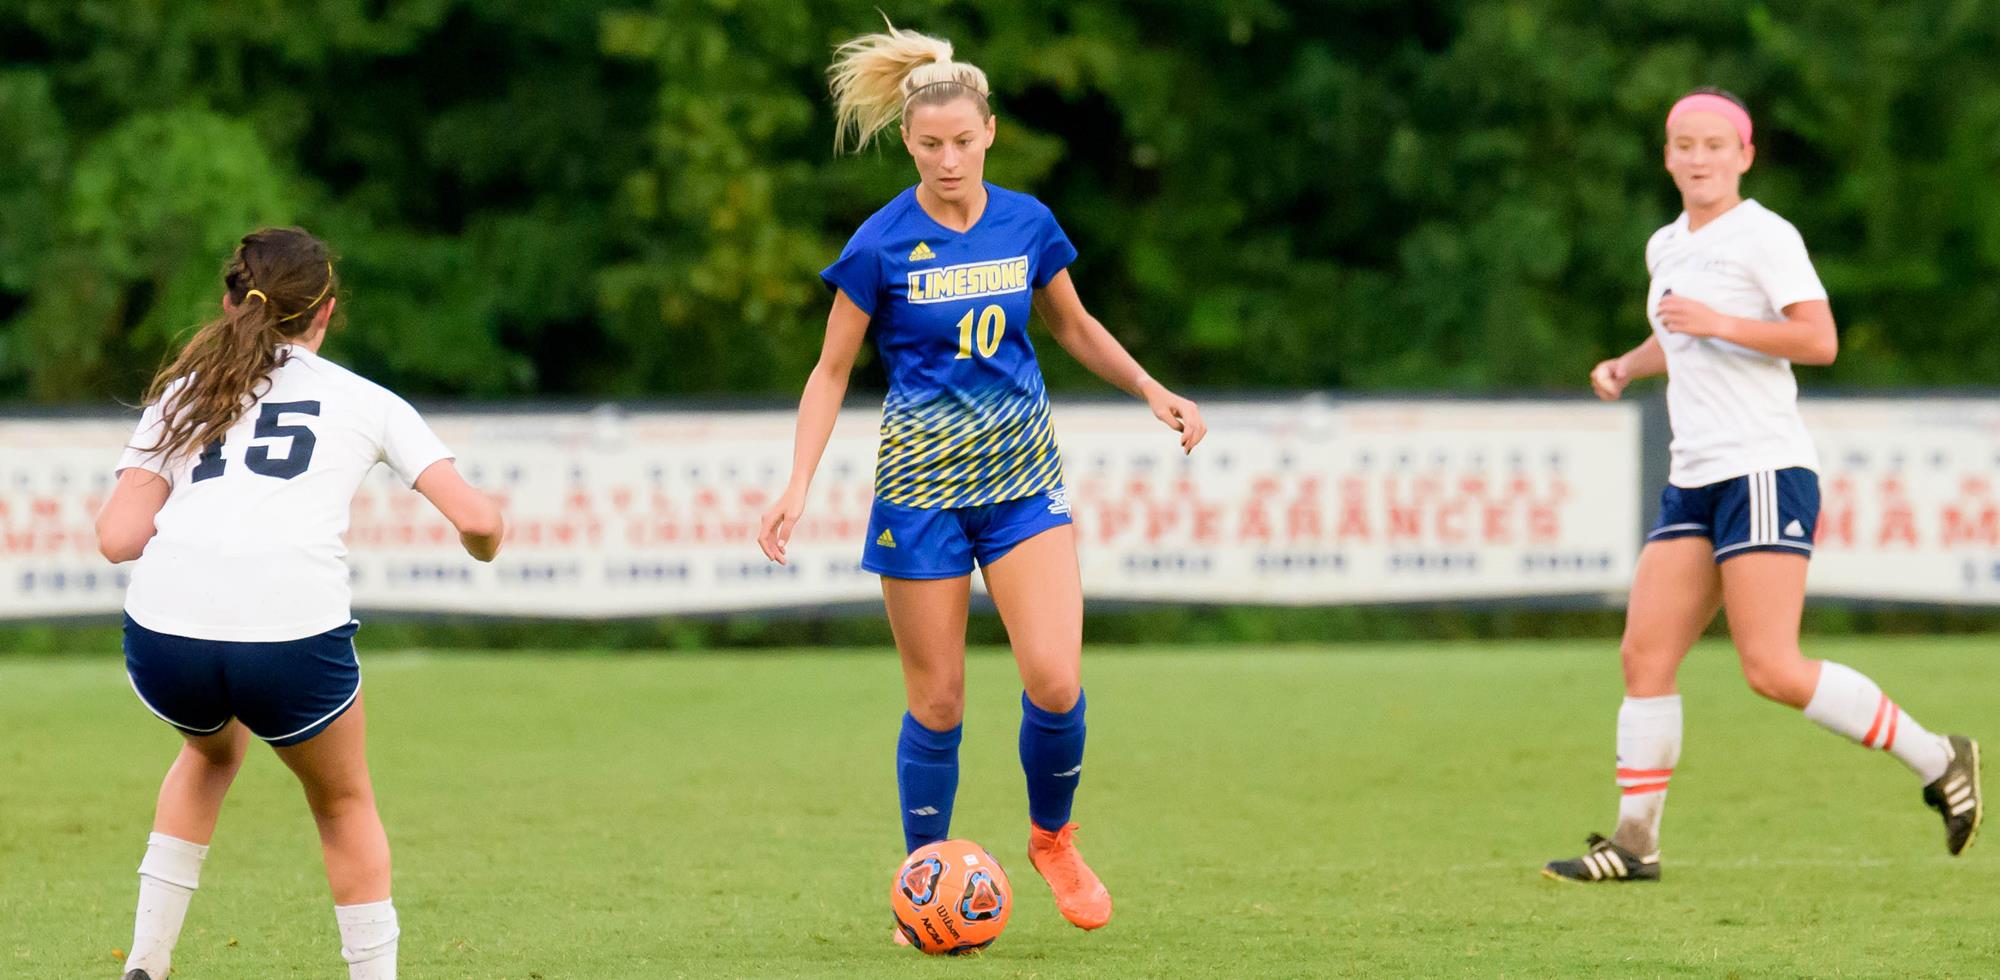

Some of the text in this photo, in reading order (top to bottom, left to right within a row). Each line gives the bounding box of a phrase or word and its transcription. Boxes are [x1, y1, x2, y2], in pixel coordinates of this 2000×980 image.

[909, 260, 1027, 301] LIMESTONE
[954, 304, 1007, 360] 10
[191, 400, 321, 484] 15
[1075, 499, 1562, 542] PPEARANCES
[936, 904, 960, 940] Wilson
